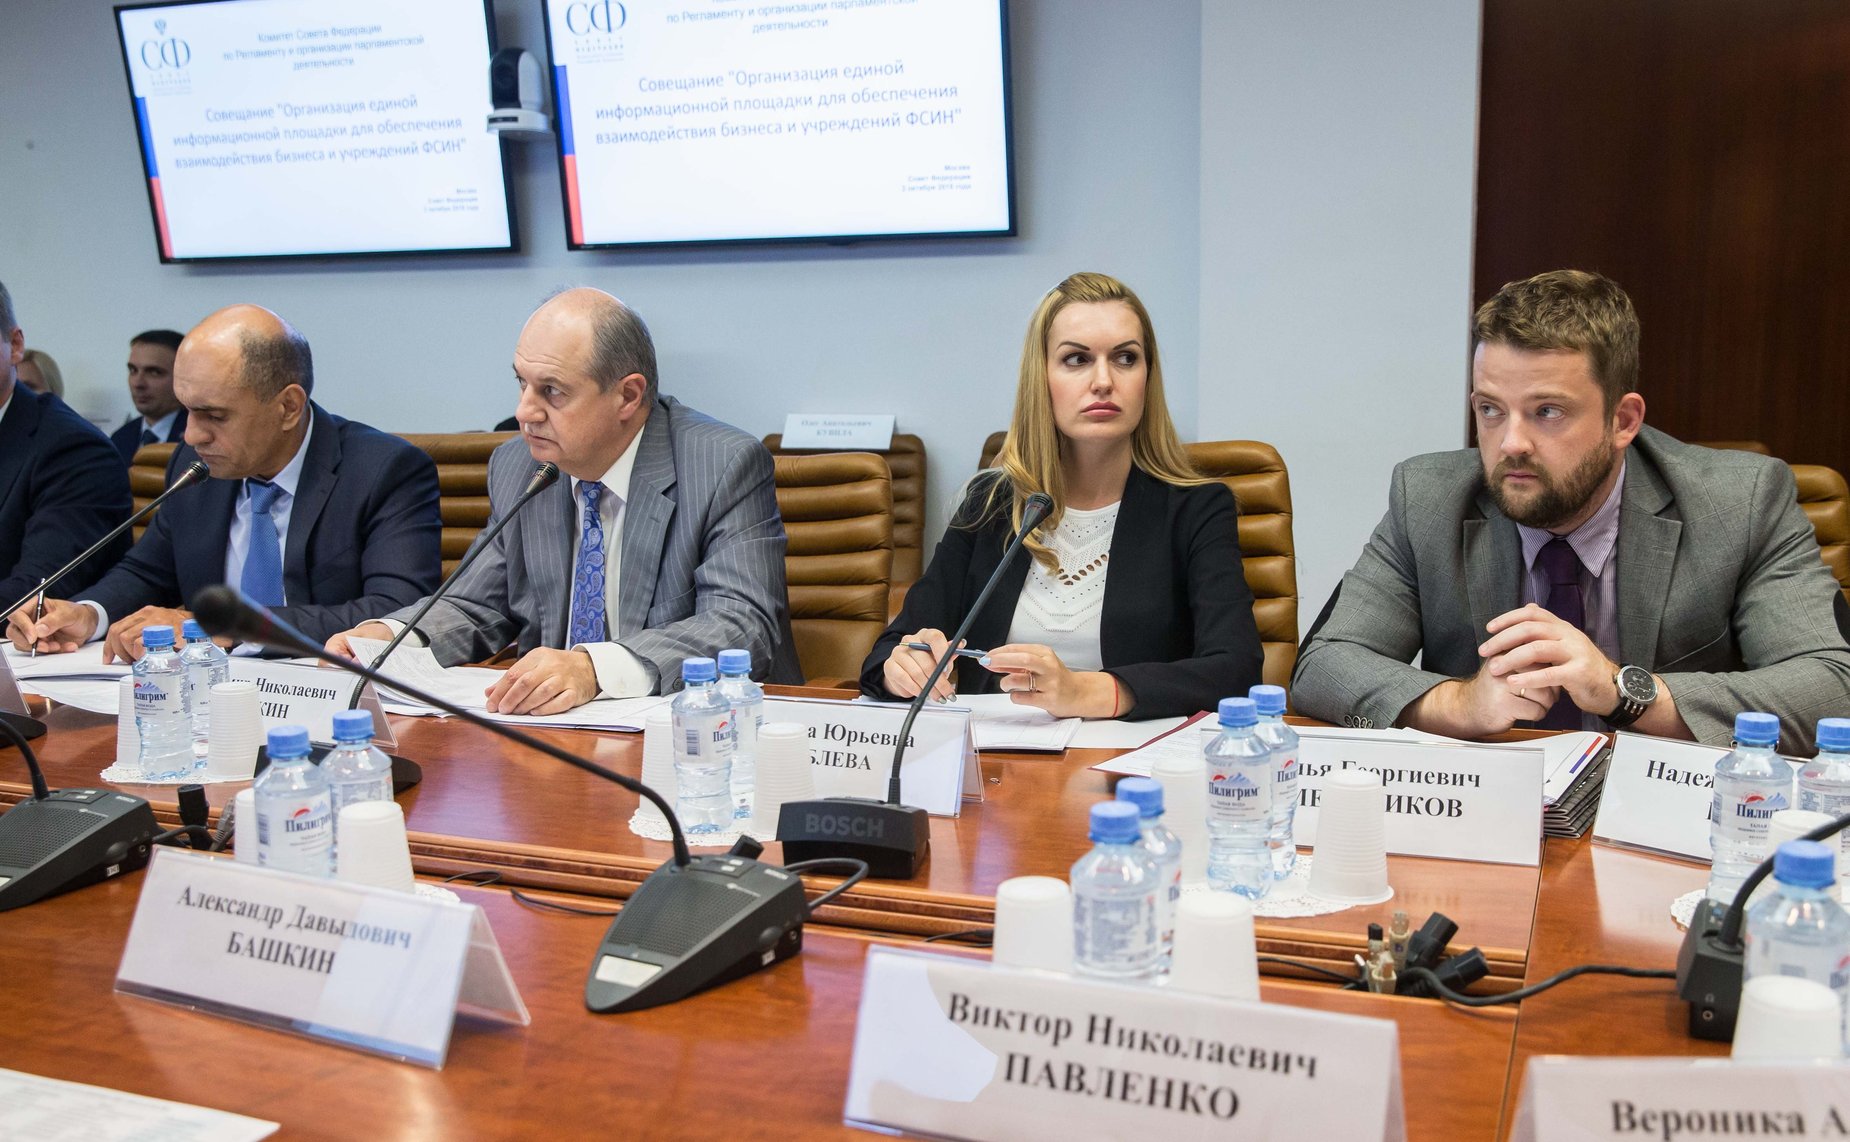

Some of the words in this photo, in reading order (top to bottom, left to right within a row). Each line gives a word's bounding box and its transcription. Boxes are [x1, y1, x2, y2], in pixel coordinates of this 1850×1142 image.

[666, 13, 680, 23] по
[682, 8, 744, 22] Регламенту
[757, 3, 828, 18] организации
[752, 18, 829, 34] деятельности
[638, 73, 724, 92] Совещание
[728, 65, 839, 87] "Организация
[843, 59, 905, 78] единой
[205, 106, 275, 123] Совещание
[277, 101, 366, 120] "Организация
[369, 94, 418, 112] единой
[595, 96, 729, 121] информационной
[734, 92, 813, 113] площадки
[818, 90, 847, 108] для
[851, 84, 959, 104] обеспечения
[173, 125, 281, 148] информационной
[284, 125, 348, 143] площадки
[351, 123, 375, 138] для
[377, 117, 462, 135] обеспечения
[595, 126, 717, 146] взаимодействия
[721, 120, 782, 138] бизнеса
[787, 122, 797, 134] и
[801, 112, 902, 137] учреждений
[905, 107, 962, 127] ФСИН"
[175, 151, 273, 169] взаимодействия
[275, 148, 325, 164] бизнеса
[340, 141, 419, 163] учреждений
[422, 136, 467, 154] ФСИН"
[256, 677, 337, 700] Николаевич
[1341, 760, 1481, 788] Гргиевич
[1209, 781, 1258, 801] Пилигрим
[1296, 788, 1464, 818] ЕИКОВ
[804, 813, 885, 839] BOSCH
[176, 885, 284, 928] Александр
[285, 903, 413, 951] Давыдович
[226, 931, 337, 975] БАШКИН
[947, 991, 1074, 1047] Виктор
[1085, 1014, 1319, 1080] Николаевич
[1003, 1052, 1241, 1122] ПАВЛЕНКО
[1610, 1099, 1806, 1142] Вероника
